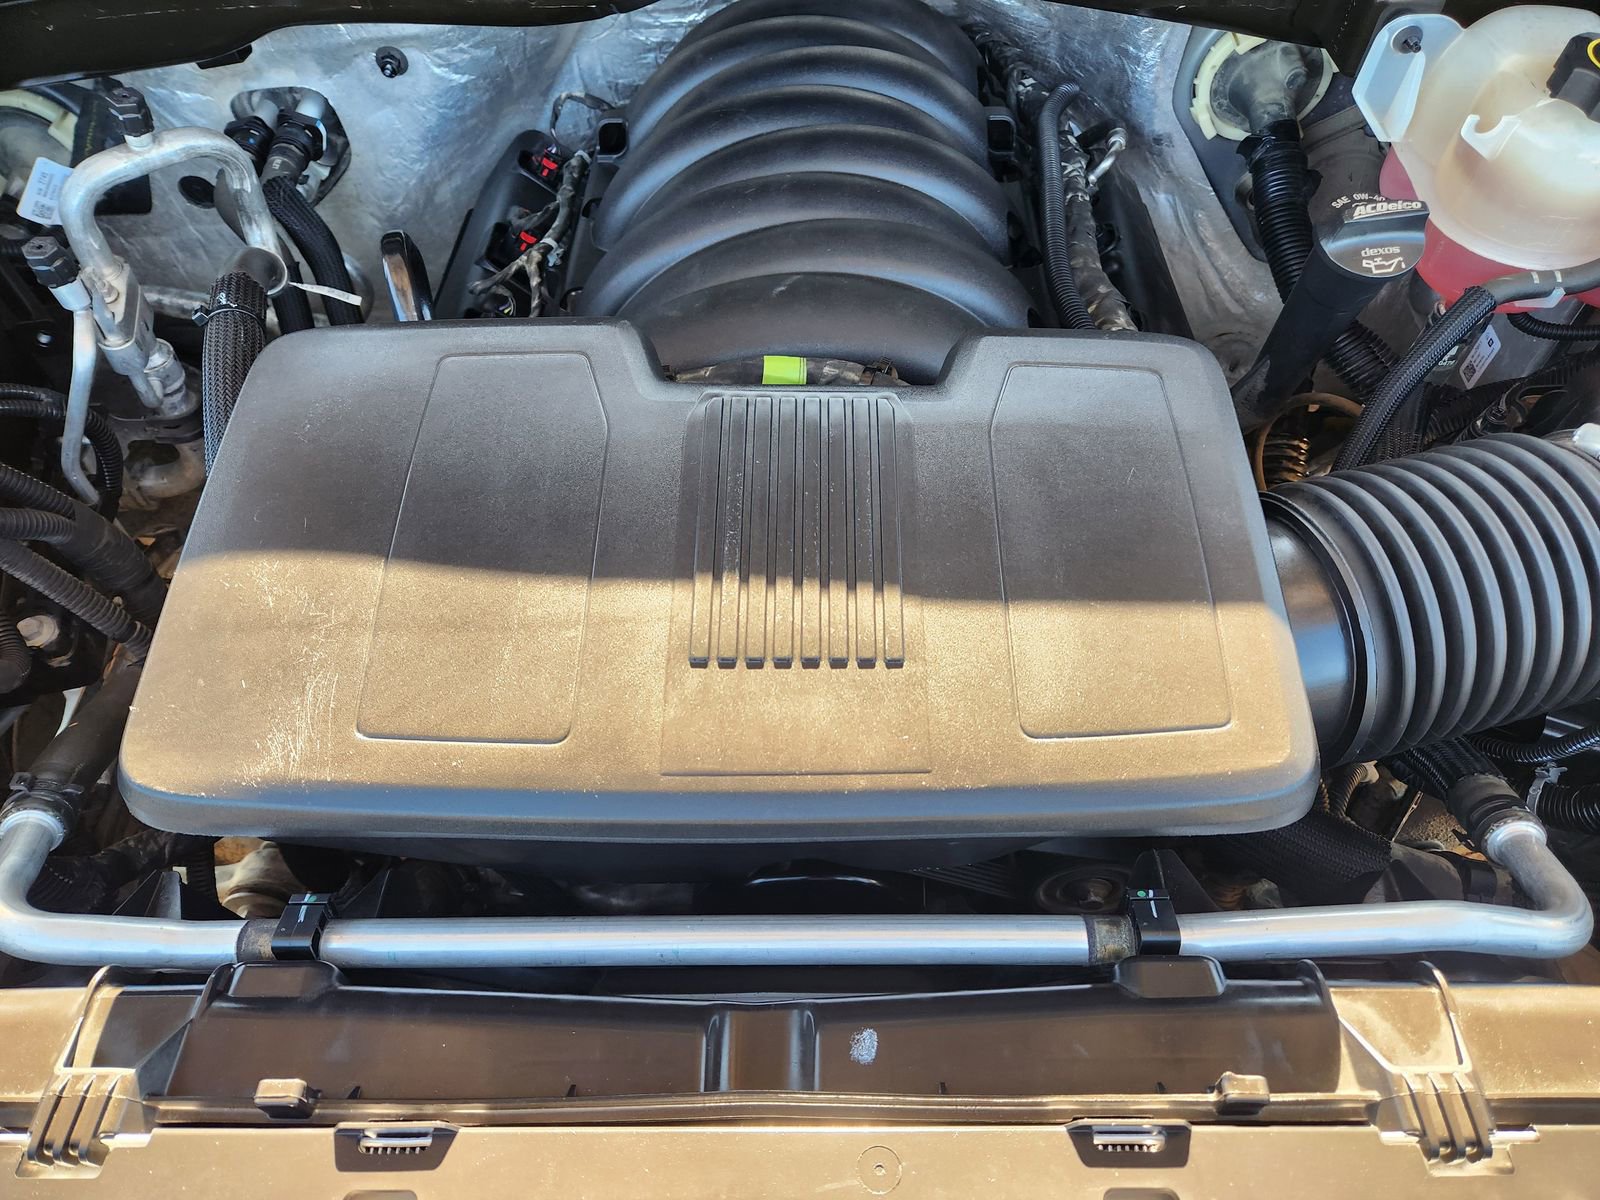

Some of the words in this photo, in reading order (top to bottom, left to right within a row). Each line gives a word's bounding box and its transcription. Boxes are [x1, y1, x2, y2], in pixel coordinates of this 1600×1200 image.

[1331, 196, 1351, 208] SAE
[1353, 200, 1421, 217] ACDelco
[1361, 246, 1401, 257] dexos
